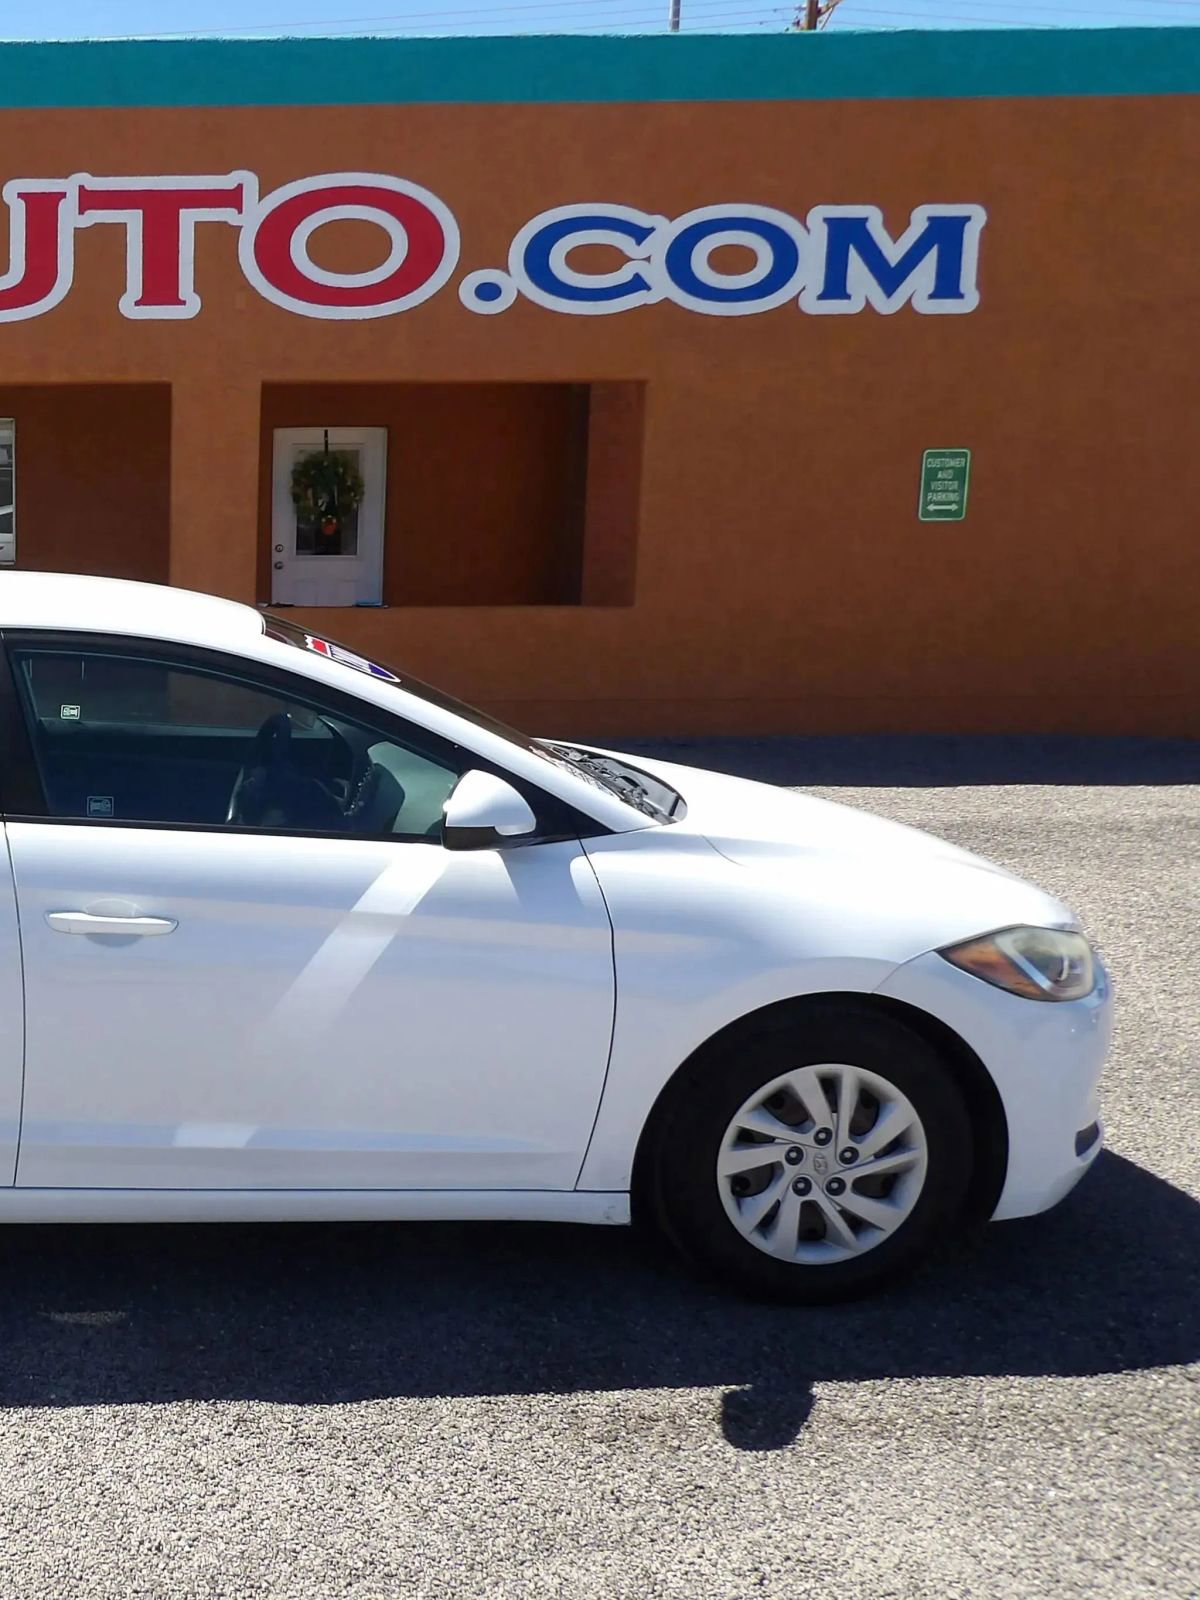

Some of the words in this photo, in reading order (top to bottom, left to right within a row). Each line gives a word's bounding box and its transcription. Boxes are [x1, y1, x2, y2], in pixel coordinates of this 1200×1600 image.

[927, 458, 966, 468] CUSTOMER
[937, 469, 954, 479] AND
[930, 481, 959, 490] VISITOR
[927, 492, 960, 501] PARKING
